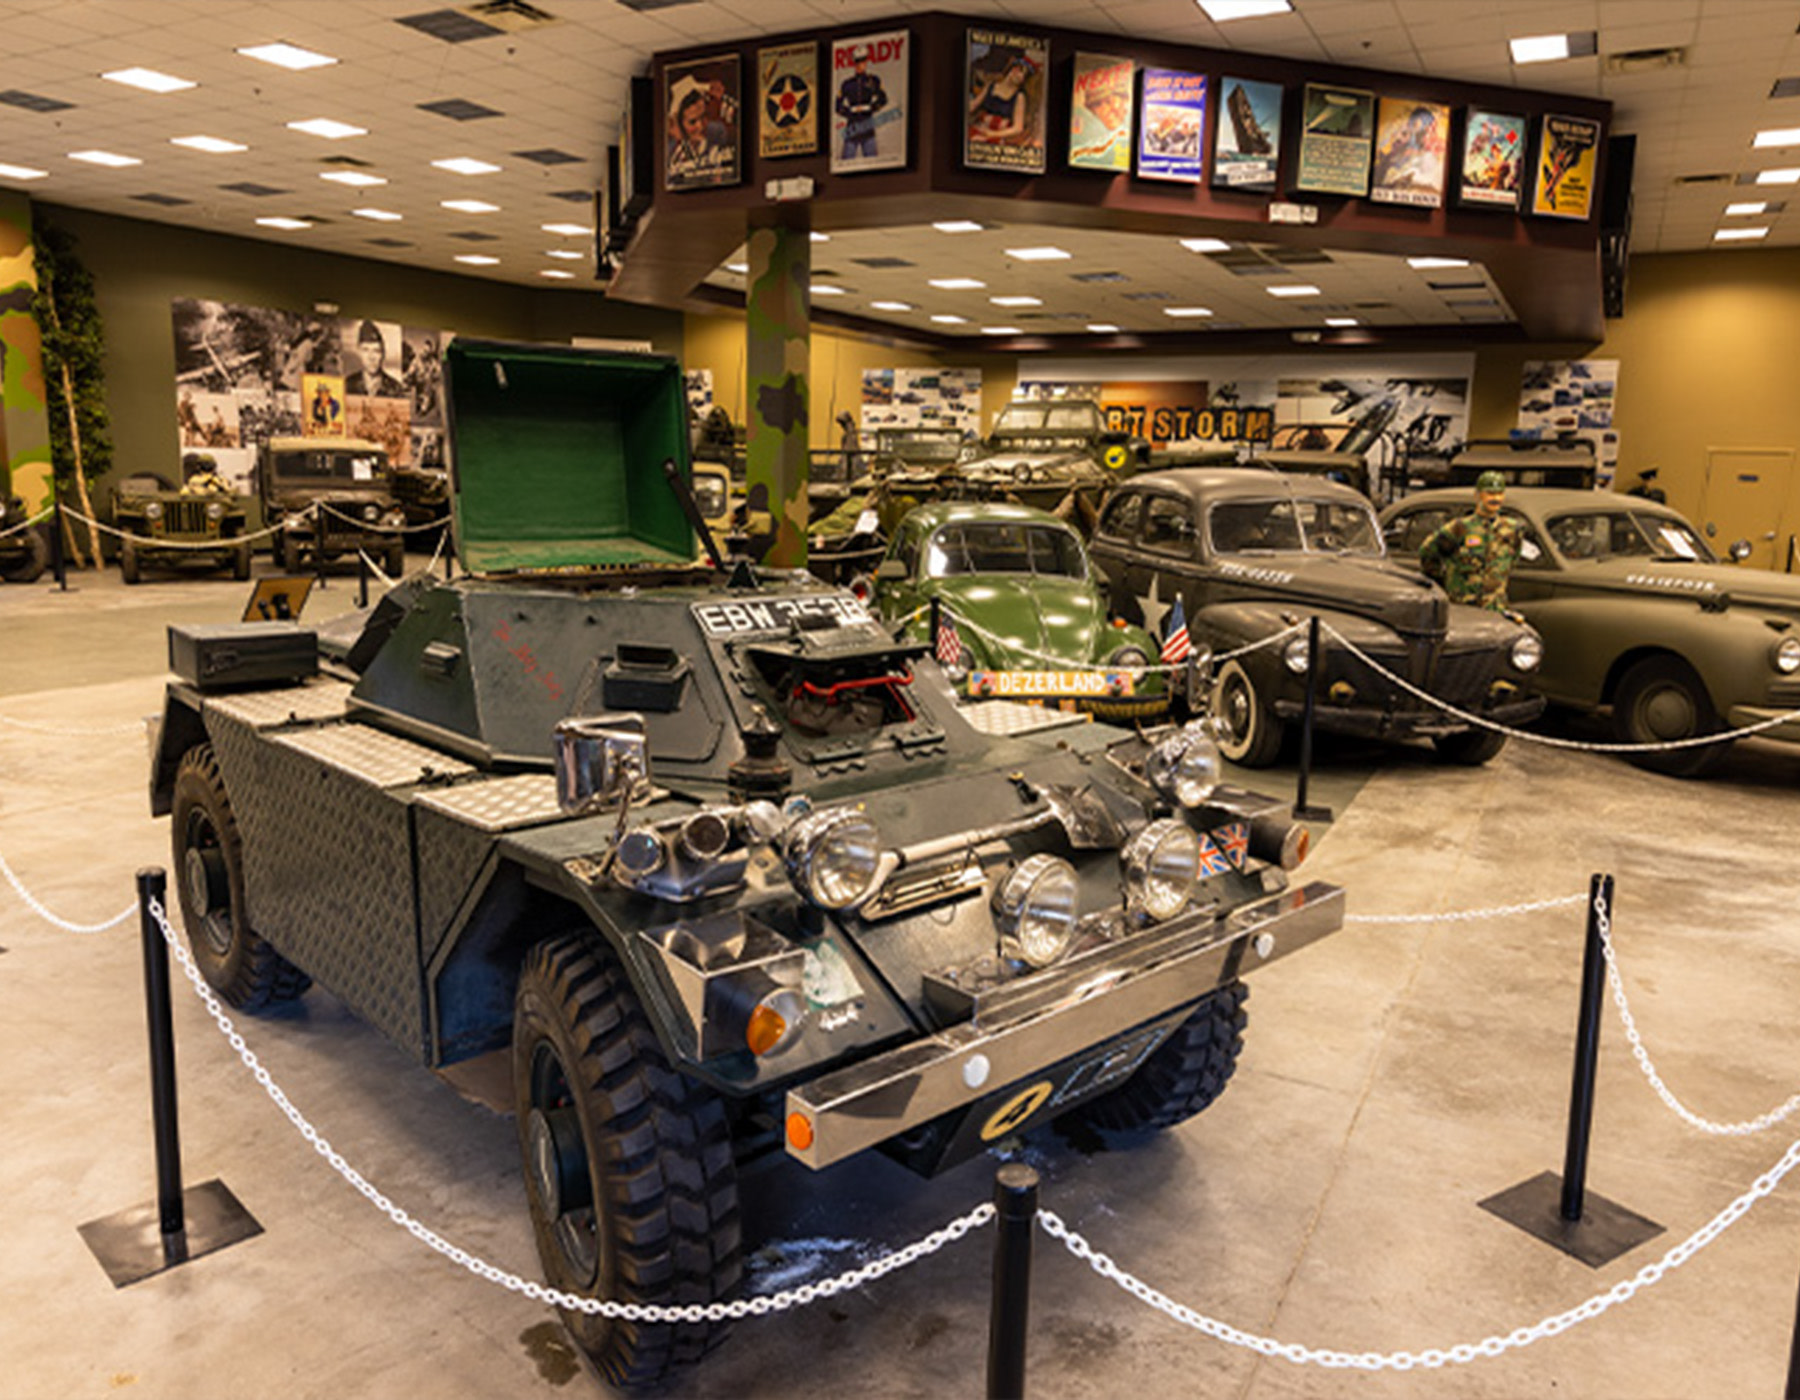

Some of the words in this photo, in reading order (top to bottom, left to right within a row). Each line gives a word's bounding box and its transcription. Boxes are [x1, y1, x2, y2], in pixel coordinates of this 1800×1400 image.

[835, 37, 905, 69] READY
[1153, 408, 1272, 441] STORM
[699, 603, 776, 632] EBW
[1000, 672, 1106, 693] DEZERLAND
